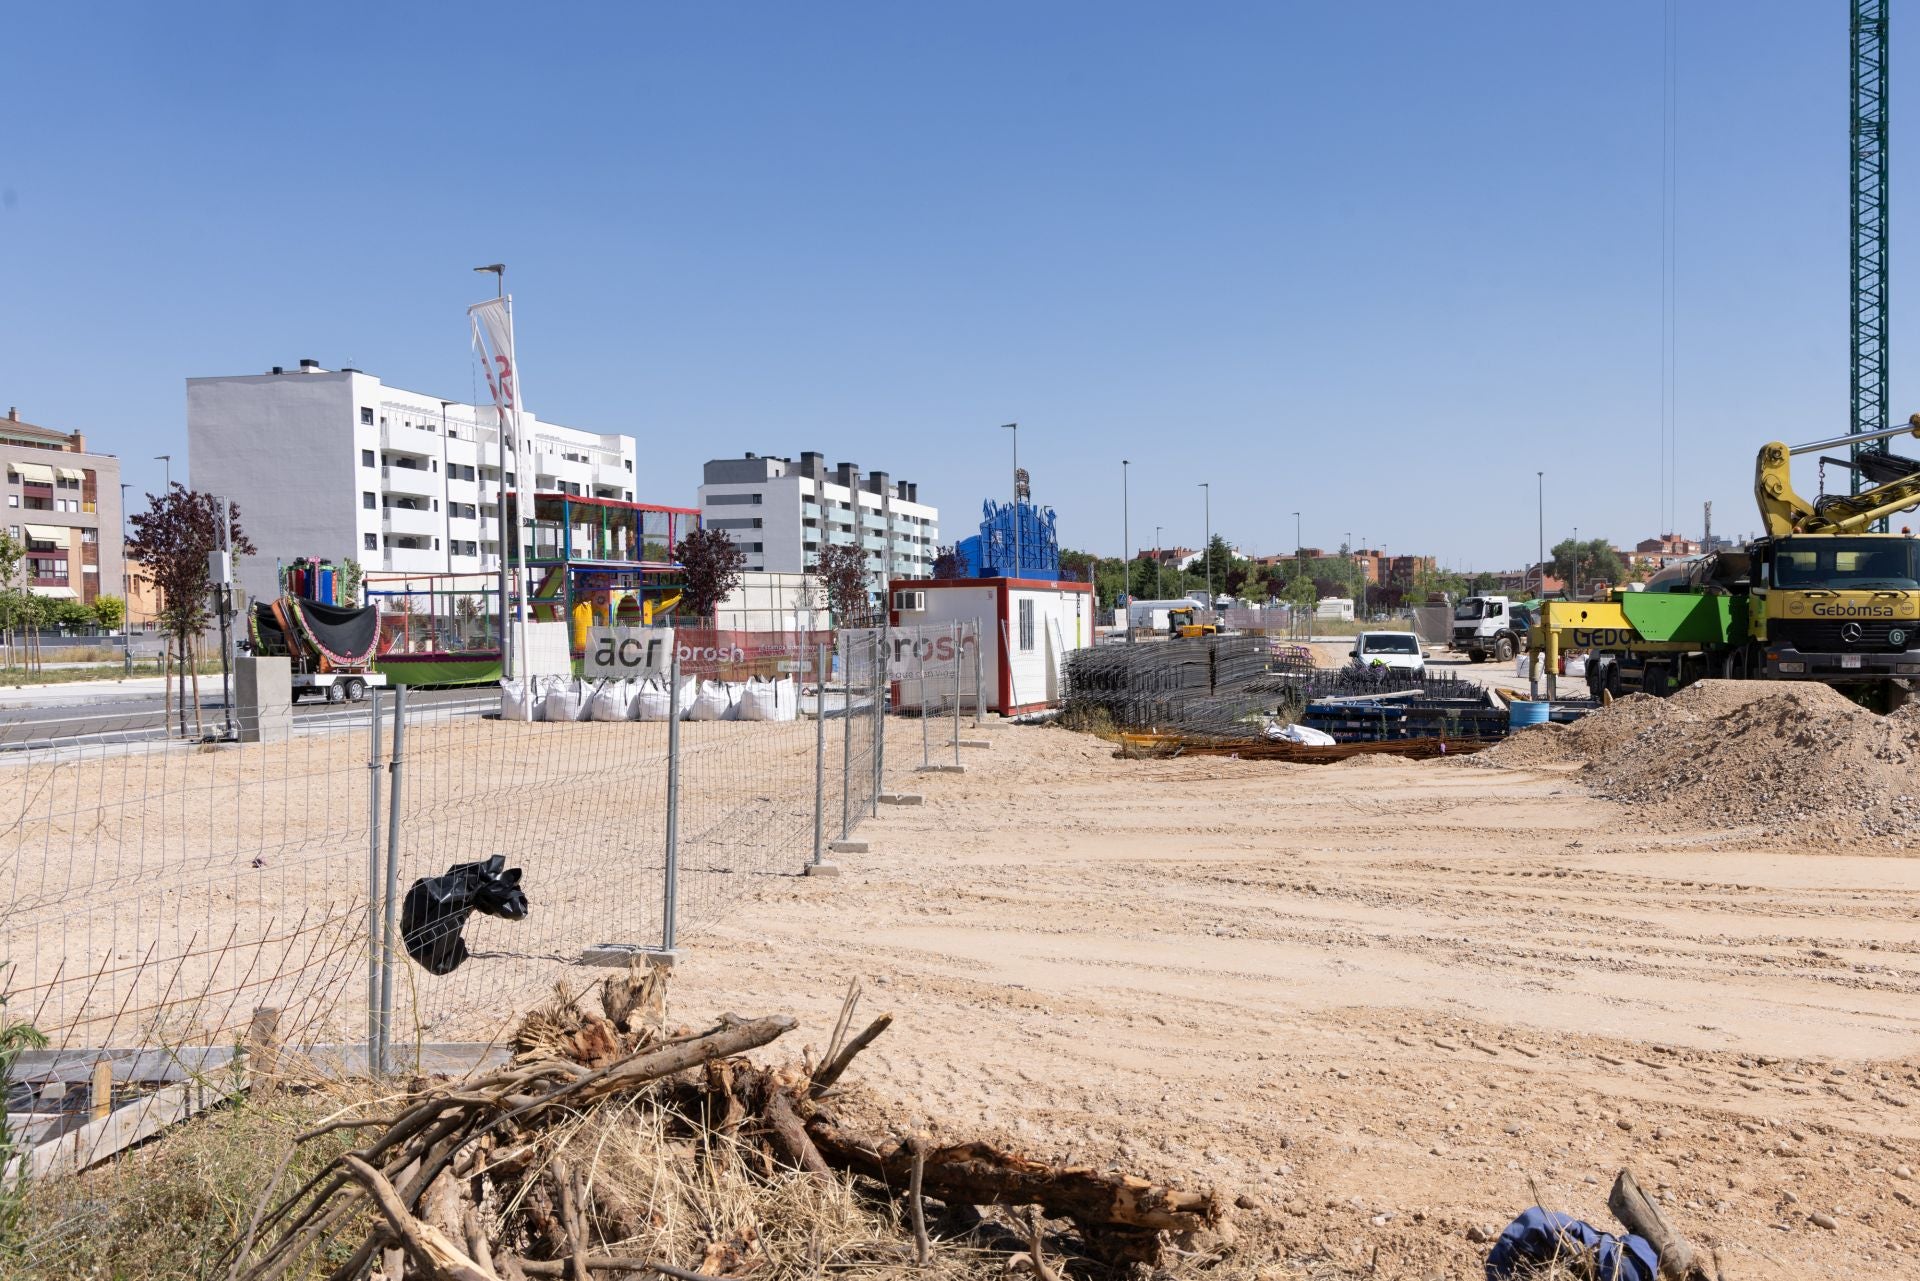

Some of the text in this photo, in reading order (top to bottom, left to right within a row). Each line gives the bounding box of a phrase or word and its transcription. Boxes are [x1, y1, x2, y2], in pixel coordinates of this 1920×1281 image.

[1813, 602, 1893, 617] Gebomsa
[1893, 632, 1901, 642] G
[595, 638, 661, 667] acr
[677, 641, 744, 663] brosh
